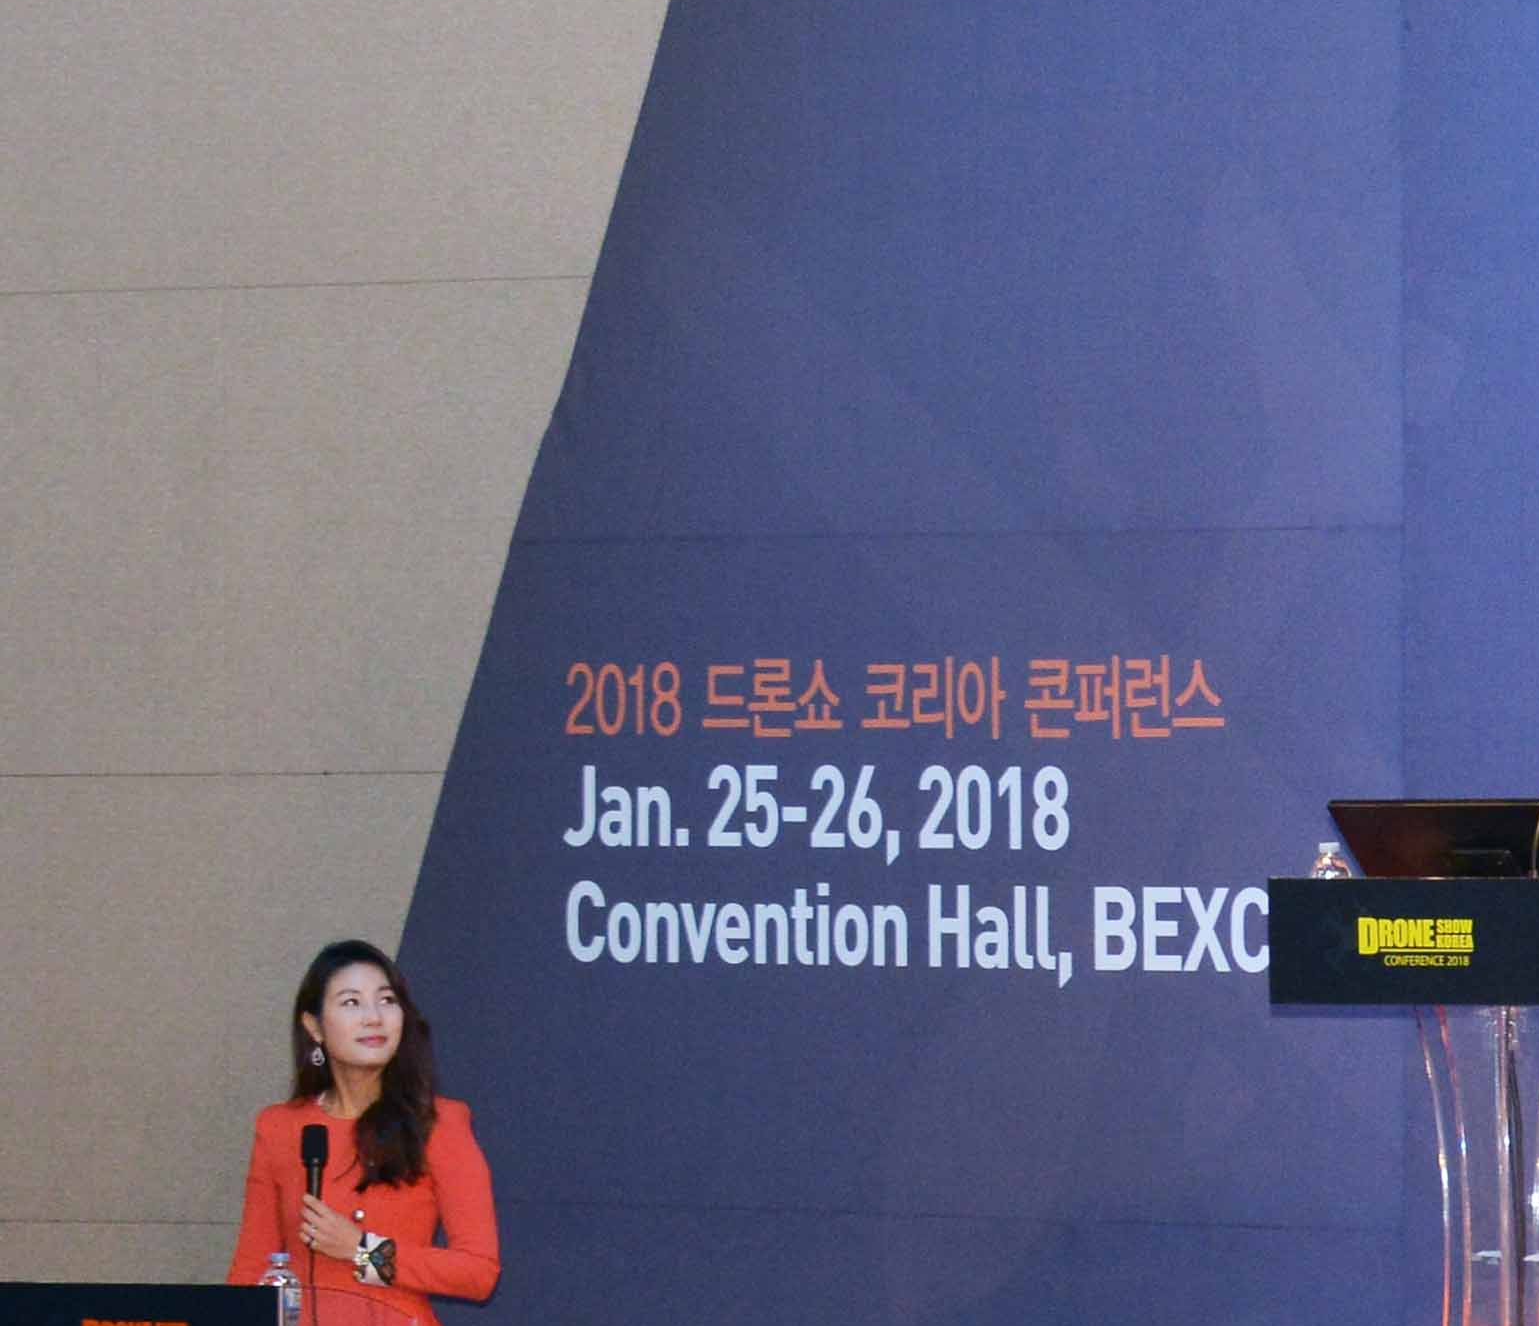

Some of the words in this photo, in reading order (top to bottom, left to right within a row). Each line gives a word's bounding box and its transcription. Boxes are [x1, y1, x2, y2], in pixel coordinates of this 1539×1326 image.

[565, 661, 683, 737] 2018
[702, 658, 844, 738] 드론쇼
[861, 655, 1006, 740] 코리아
[1024, 655, 1225, 740] 콘퍼런스
[562, 764, 690, 849] Jan.
[707, 764, 901, 866] 25-26,
[919, 764, 1070, 852] 2018
[565, 880, 909, 968] Convention
[928, 883, 1073, 989] Hall,
[1094, 886, 1270, 974] BEXC
[1358, 917, 1434, 955] DRONE
[1436, 919, 1473, 933] SHOW
[1384, 955, 1444, 966] CONFERENCE
